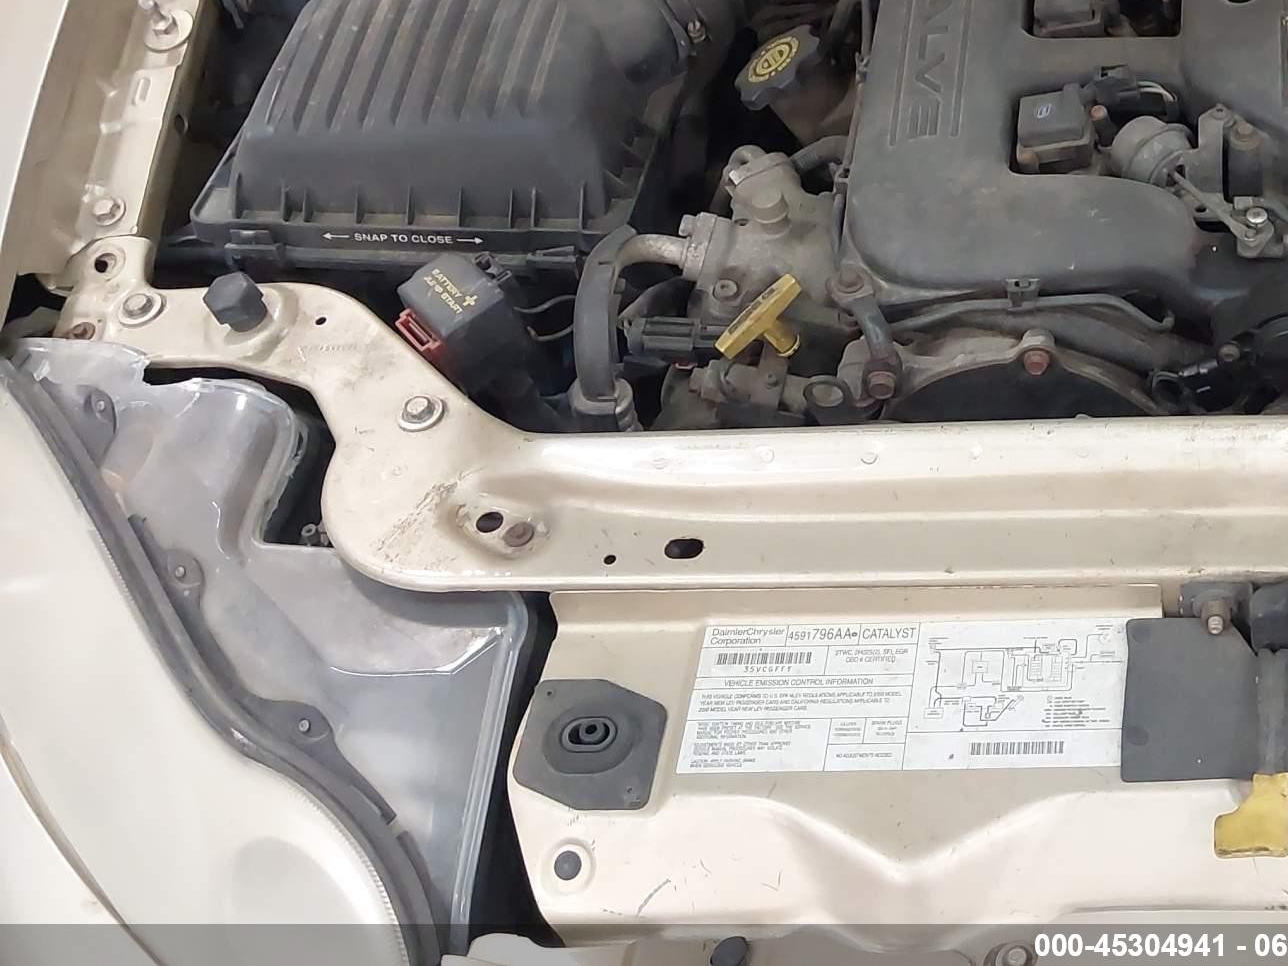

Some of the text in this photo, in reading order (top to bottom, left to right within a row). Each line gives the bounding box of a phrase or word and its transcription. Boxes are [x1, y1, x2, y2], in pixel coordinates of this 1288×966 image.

[354, 232, 453, 244] SNAP TO CLOSE
[431, 268, 462, 299] BATTERY
[440, 290, 464, 315] START
[712, 628, 786, 637] DaimlerChrysler
[862, 627, 917, 640] CATALYST
[710, 636, 762, 646] Corporation
[755, 679, 789, 687] EMISSION
